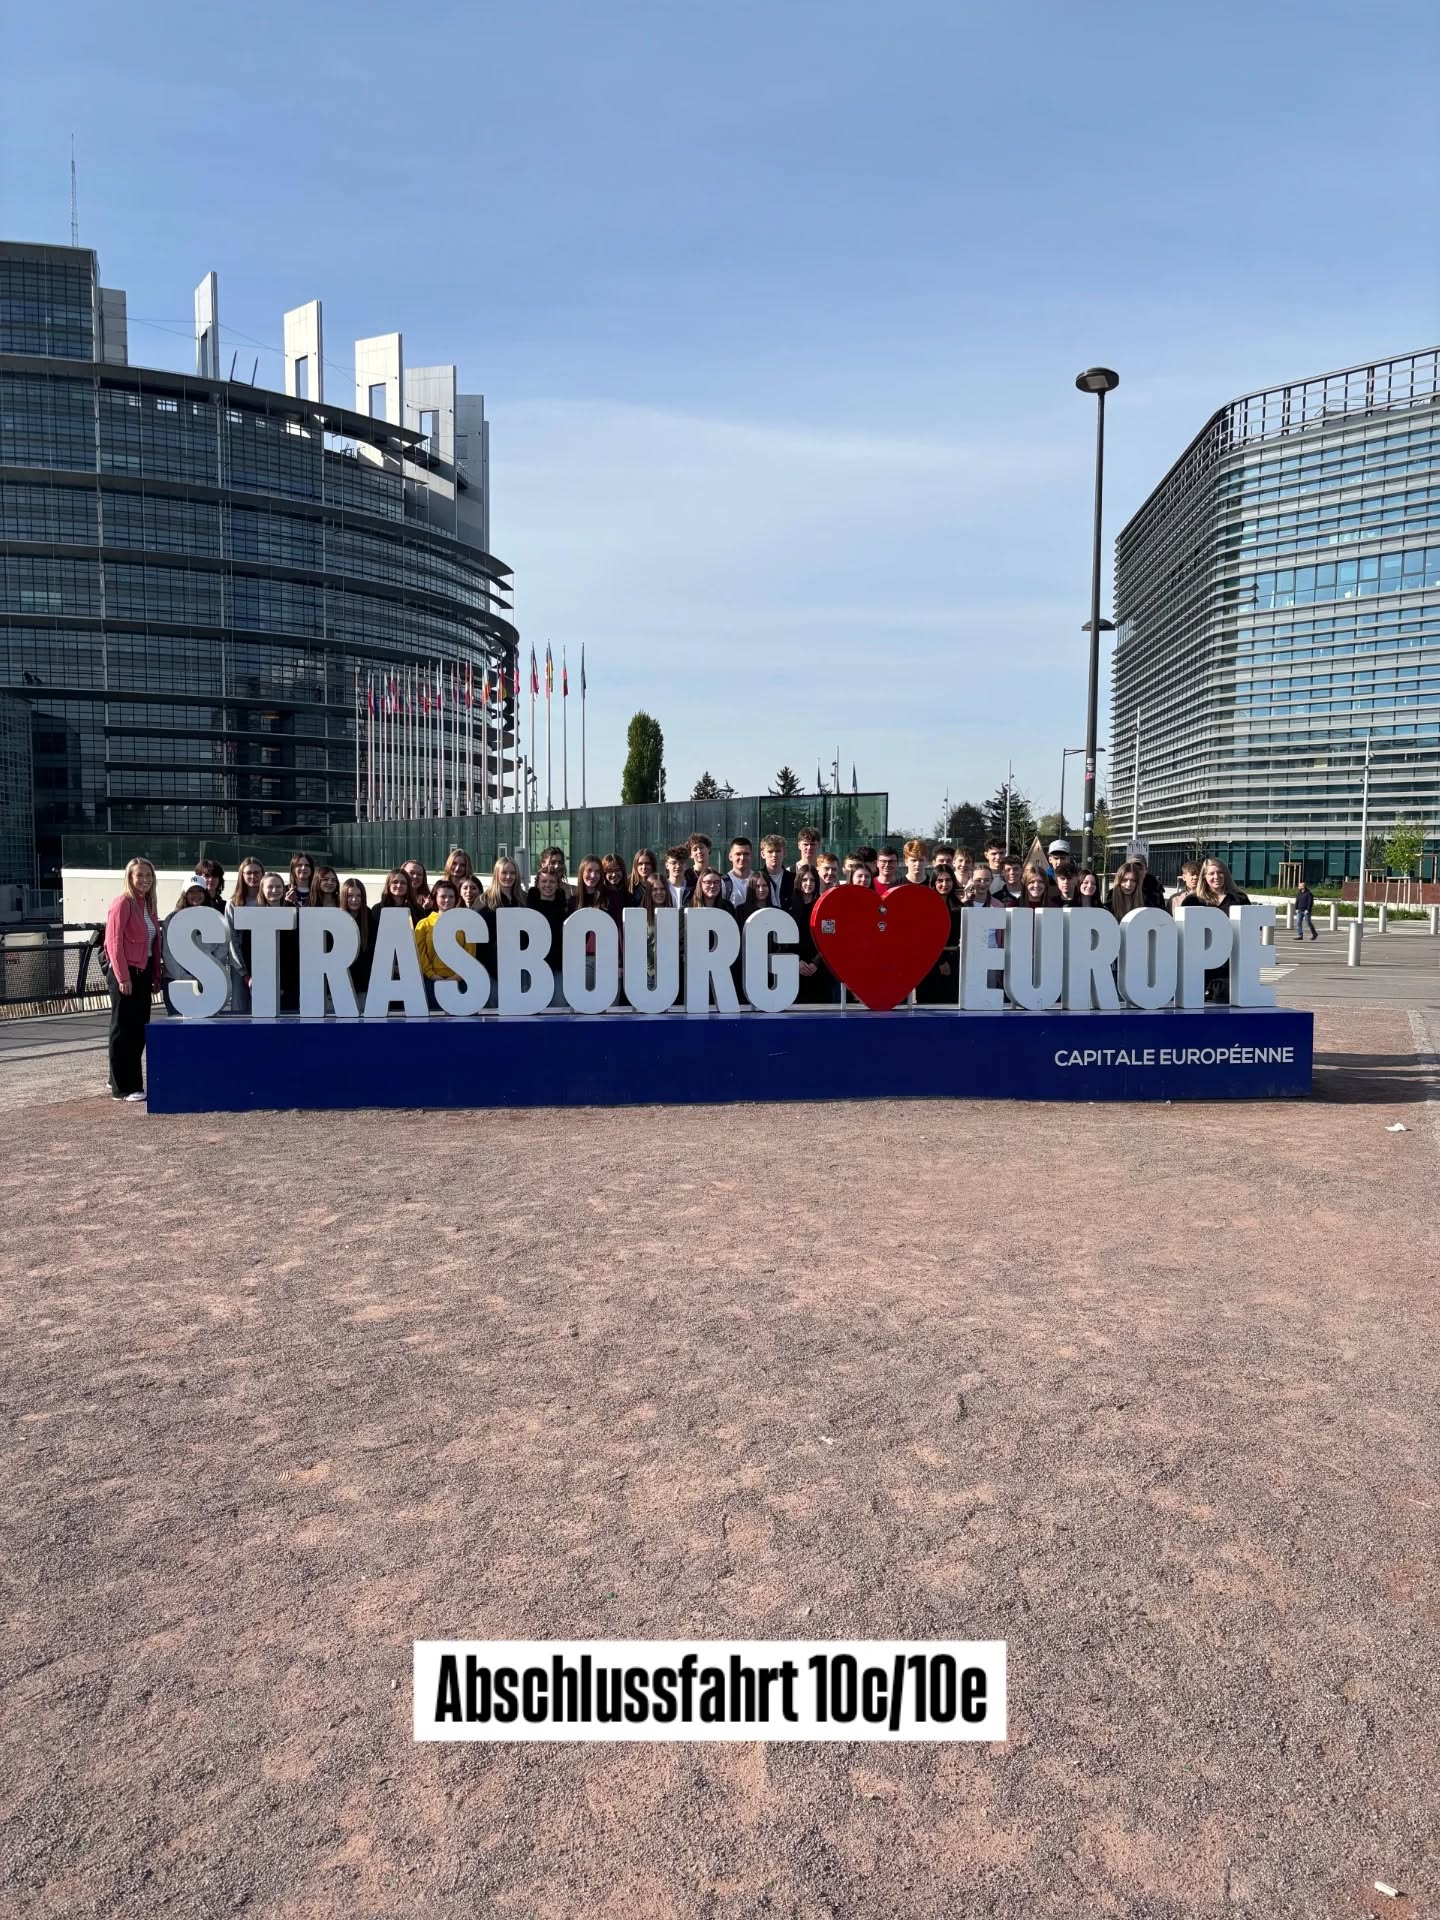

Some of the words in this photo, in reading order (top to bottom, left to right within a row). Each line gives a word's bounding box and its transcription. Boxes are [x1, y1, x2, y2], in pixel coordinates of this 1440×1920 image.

[165, 906, 800, 1018] STRASBOURG
[960, 905, 1276, 1011] EUROPE
[1054, 1049, 1155, 1067] CAPITALE
[1160, 1044, 1294, 1065] EUROPÉENNE
